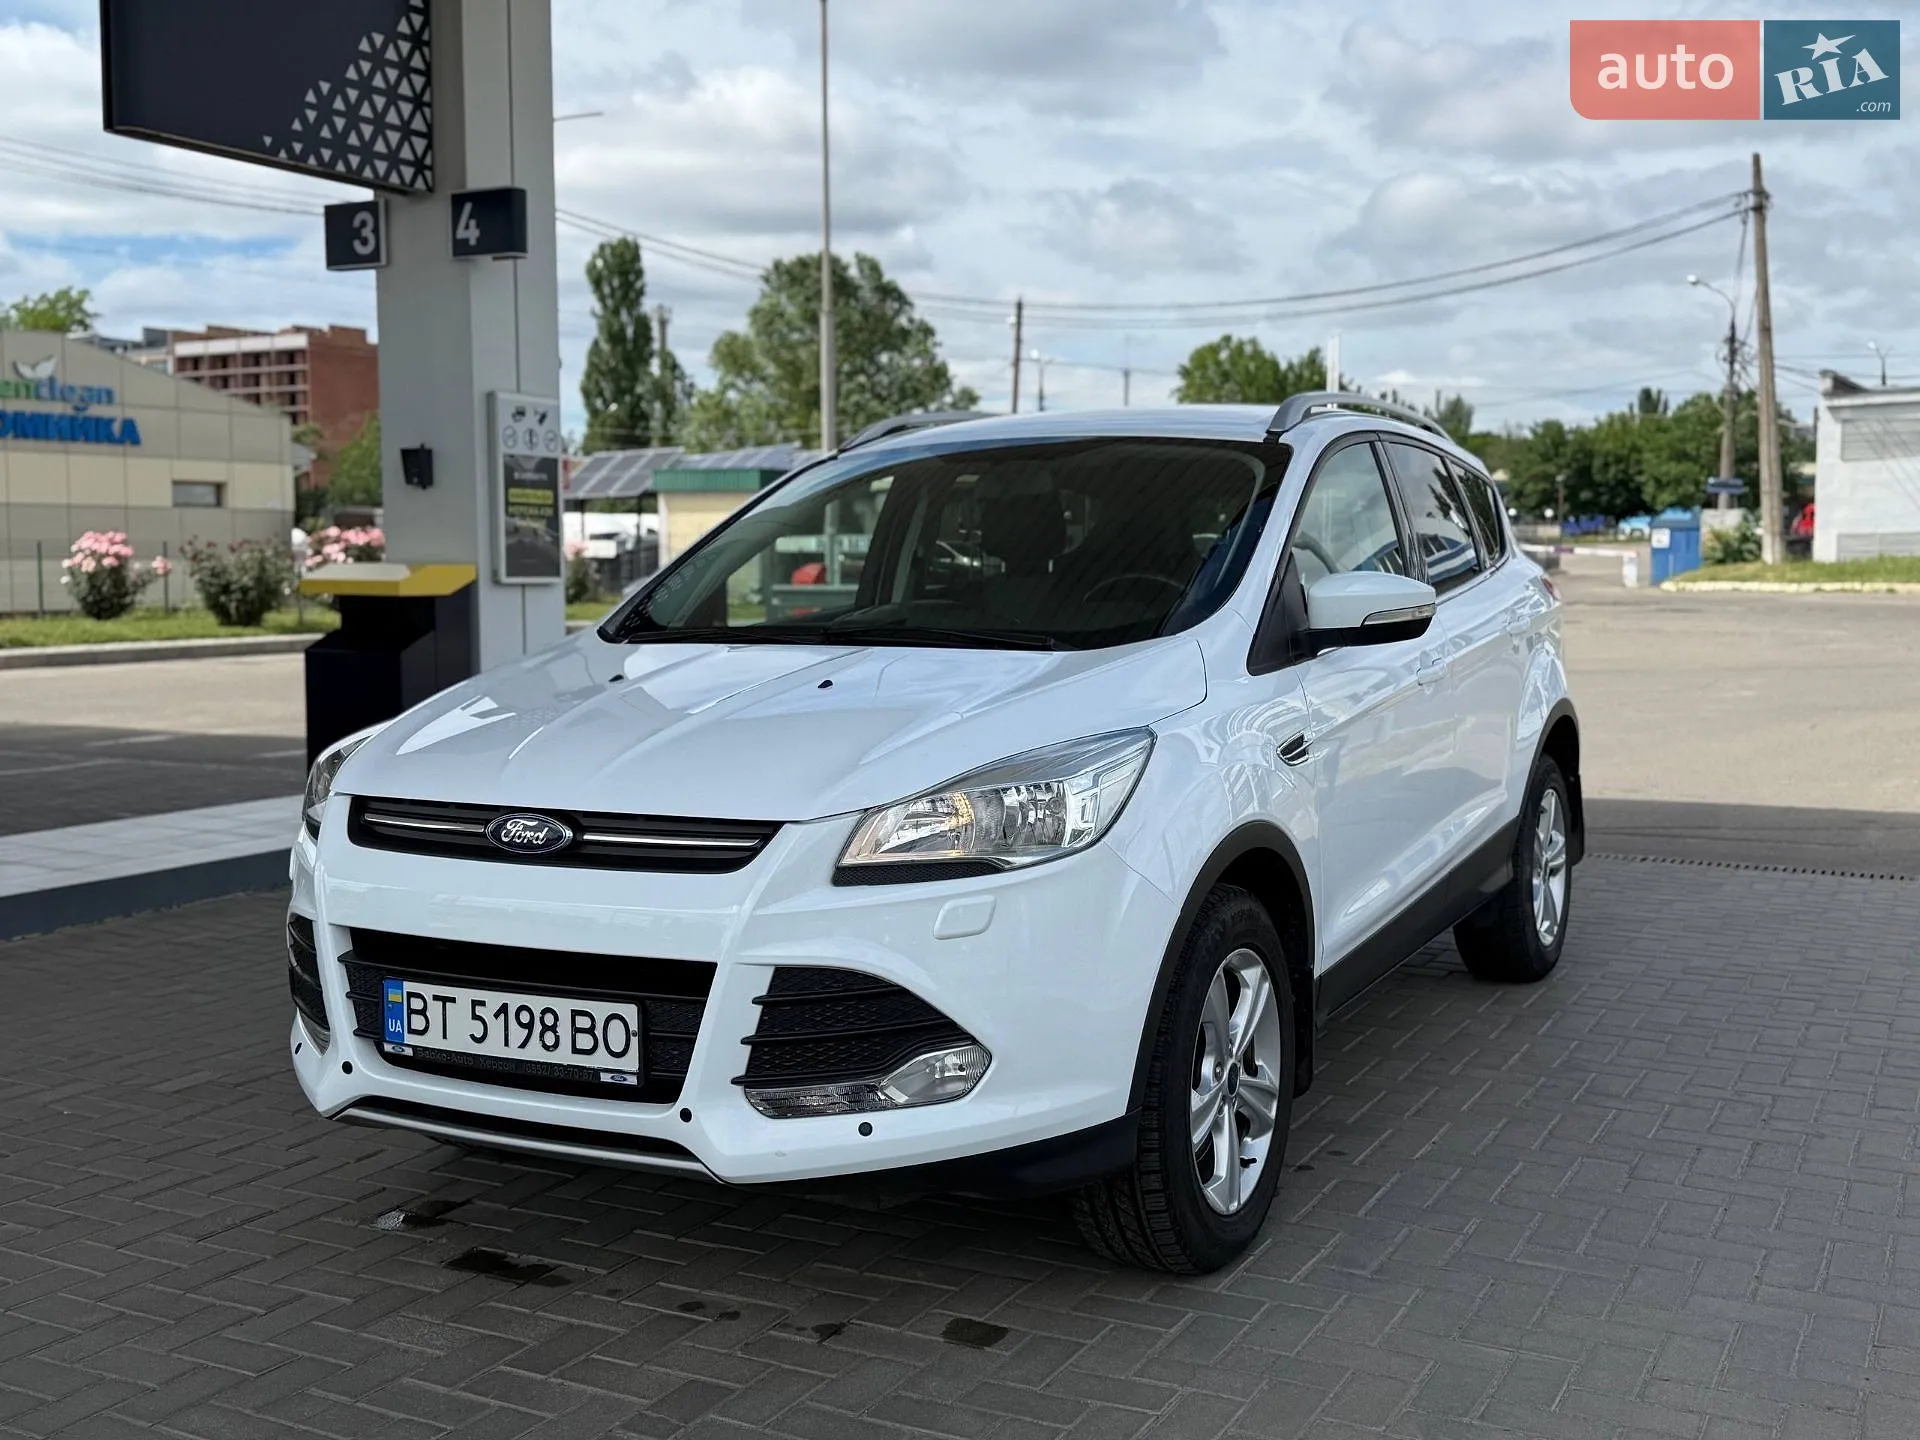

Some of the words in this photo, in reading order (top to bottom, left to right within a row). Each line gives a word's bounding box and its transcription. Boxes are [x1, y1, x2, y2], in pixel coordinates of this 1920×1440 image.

[352, 210, 376, 255] 3
[455, 201, 481, 246] 4
[500, 818, 549, 845] Ford
[388, 1017, 403, 1034] UA
[405, 990, 457, 1040] BT
[468, 998, 561, 1052] 5198
